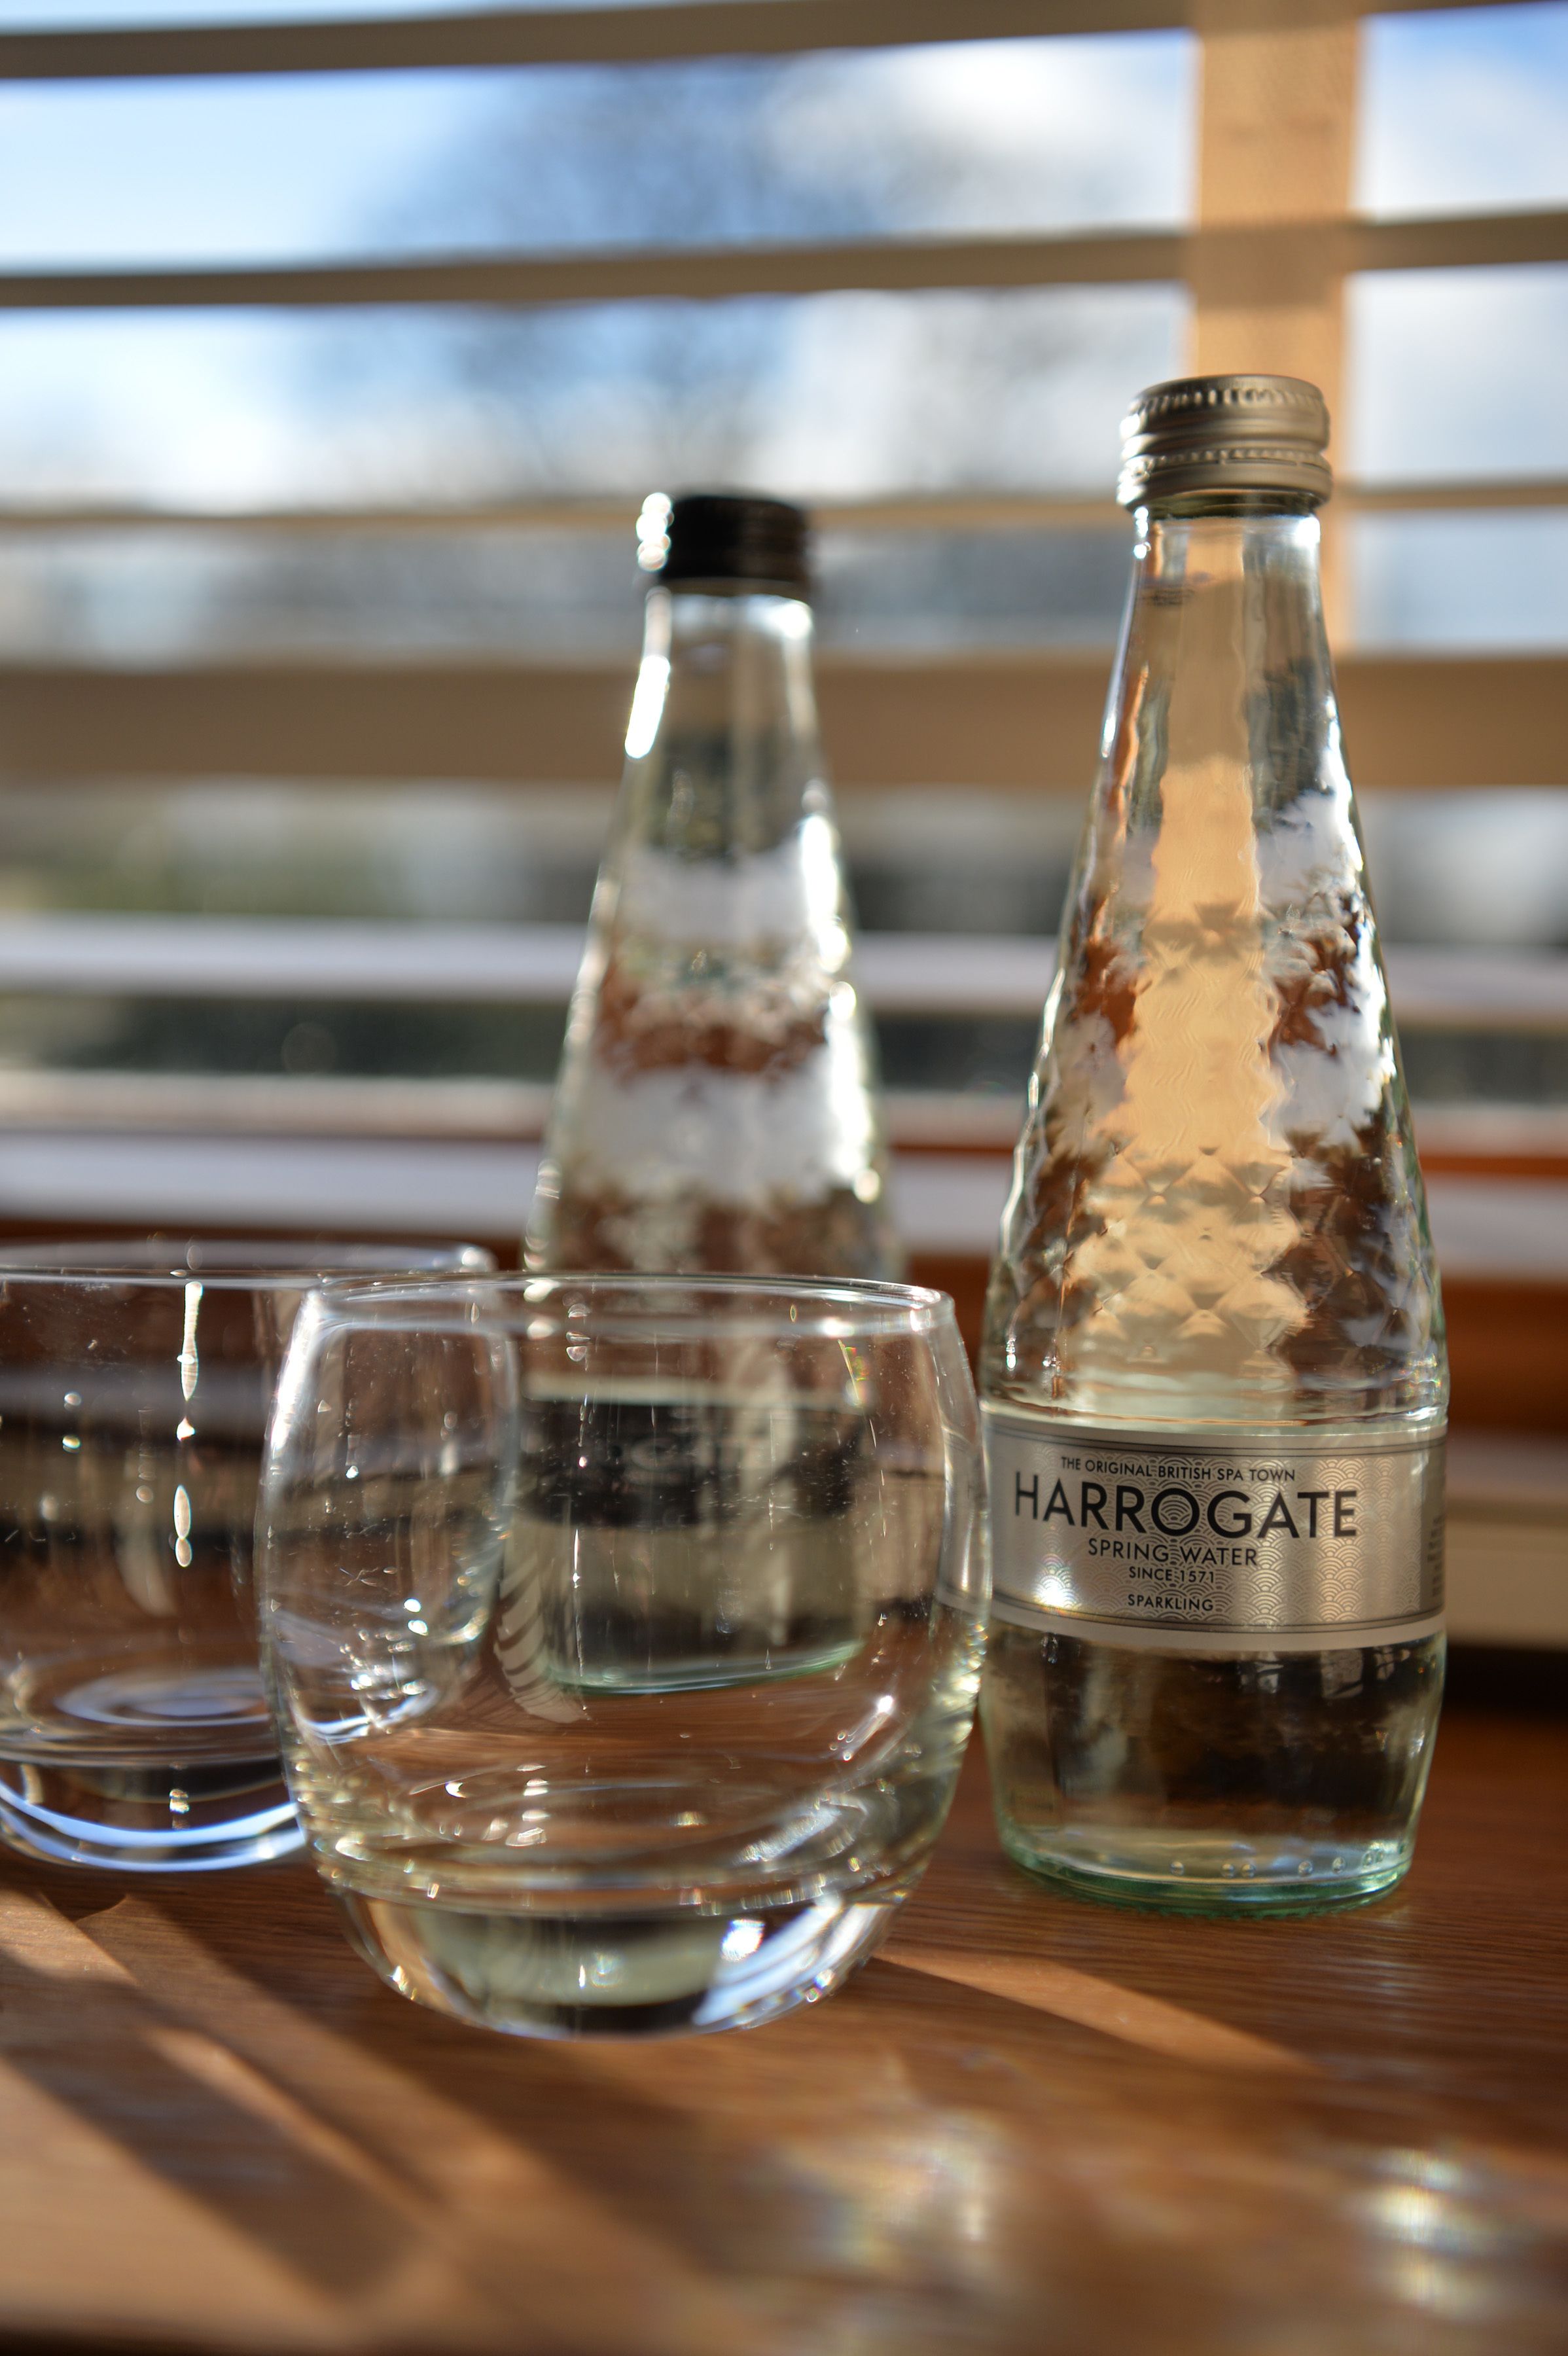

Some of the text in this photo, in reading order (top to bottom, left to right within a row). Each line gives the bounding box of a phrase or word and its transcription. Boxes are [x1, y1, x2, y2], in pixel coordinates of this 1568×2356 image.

[1061, 1456, 1295, 1482] THE ORIGINAL BRITISH SPA TOWN
[1015, 1471, 1357, 1539] HARROGATE
[1088, 1538, 1258, 1566] SPRING WATER
[1128, 1566, 1215, 1583] SINCE 1571
[1128, 1594, 1214, 1612] SPARKLING
